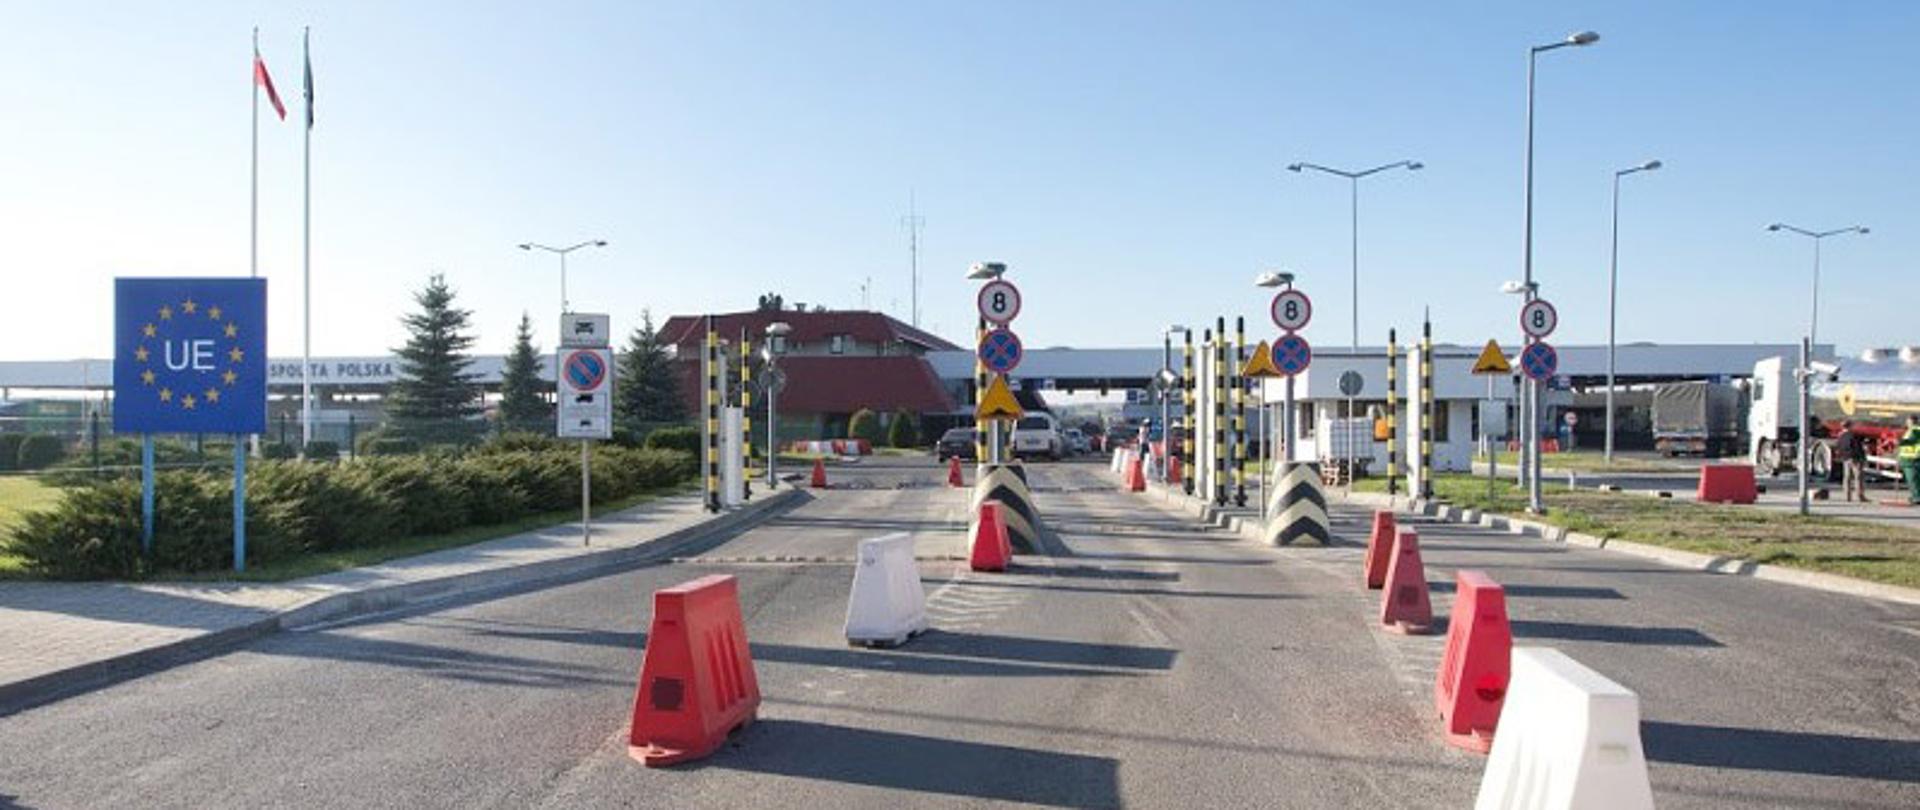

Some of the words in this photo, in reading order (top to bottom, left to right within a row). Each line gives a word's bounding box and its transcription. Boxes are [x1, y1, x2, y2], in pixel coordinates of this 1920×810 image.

[992, 292, 1005, 313] 8
[1284, 300, 1298, 320] 8
[1532, 310, 1545, 328] 8
[165, 340, 216, 370] UE
[337, 363, 392, 376] POLSKA
